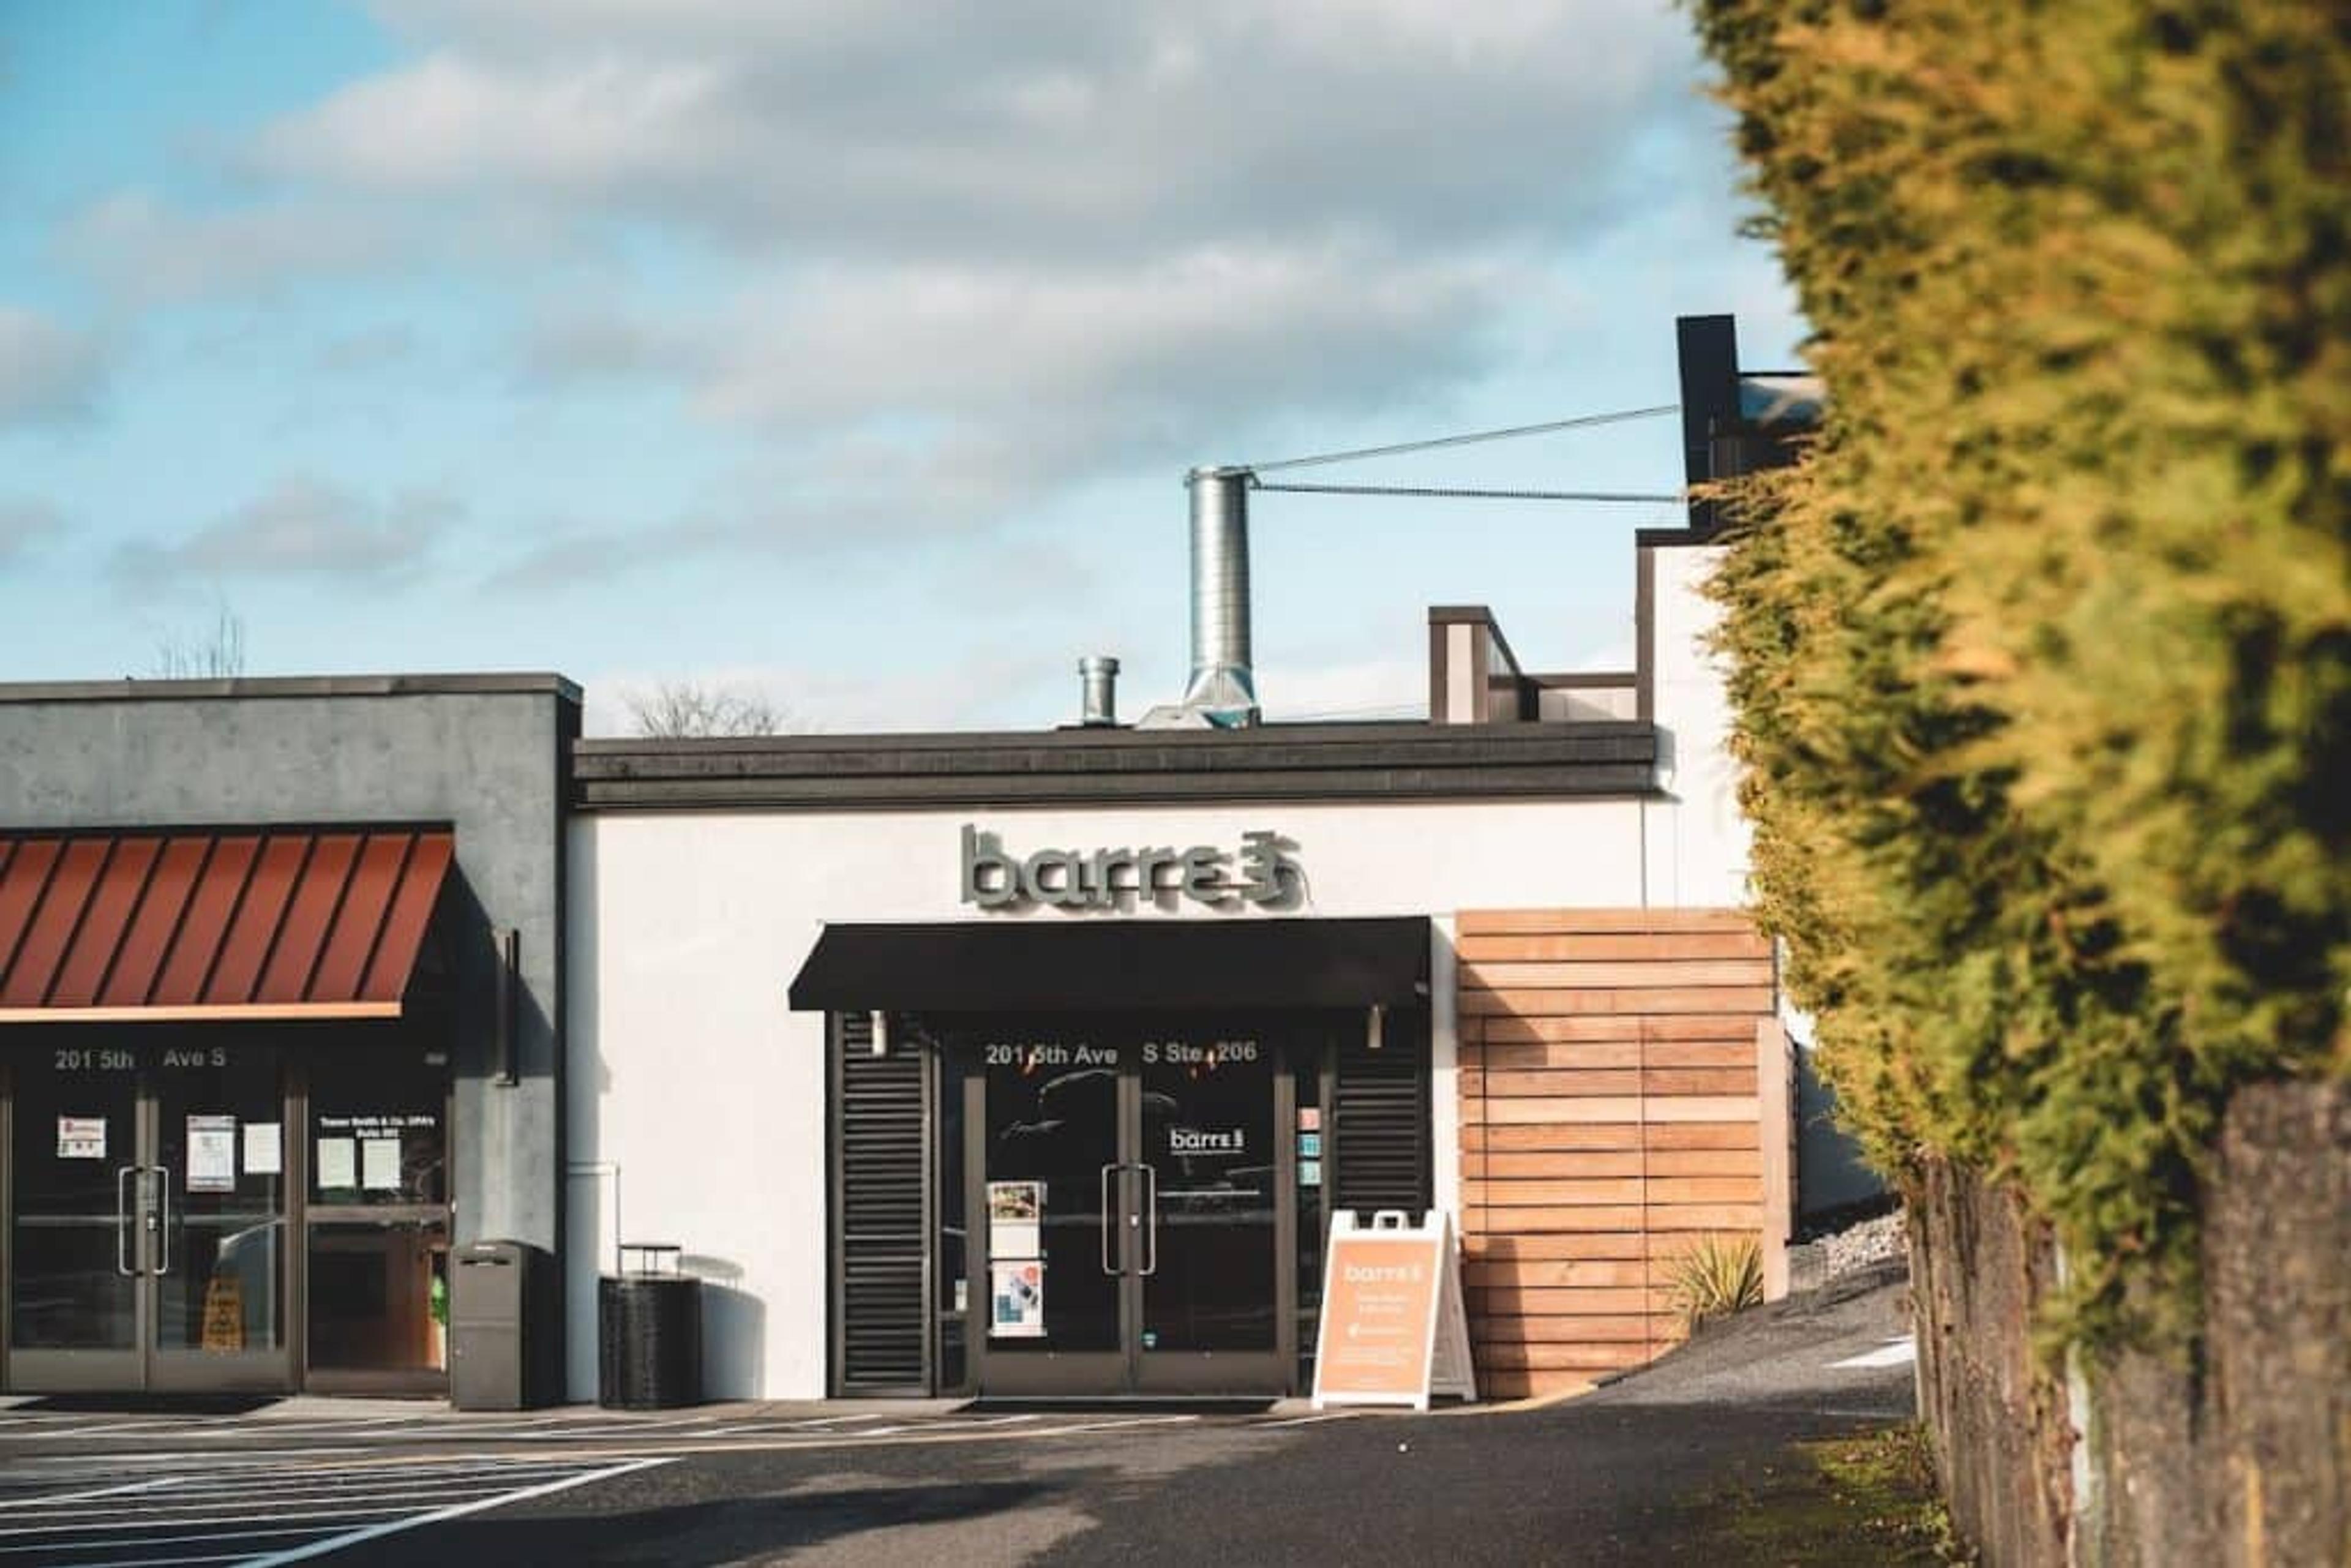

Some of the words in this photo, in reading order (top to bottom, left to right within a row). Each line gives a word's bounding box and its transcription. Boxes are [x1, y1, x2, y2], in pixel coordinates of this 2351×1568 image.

[55, 1048, 91, 1069] 201
[99, 1049, 134, 1070] 5th
[163, 1047, 204, 1067] Ave
[211, 1046, 226, 1066] S
[985, 1043, 1023, 1065] 201
[1031, 1043, 1068, 1065] 5th
[1074, 1043, 1117, 1065] Ave
[1142, 1043, 1158, 1063] S
[1217, 1042, 1257, 1062] 206
